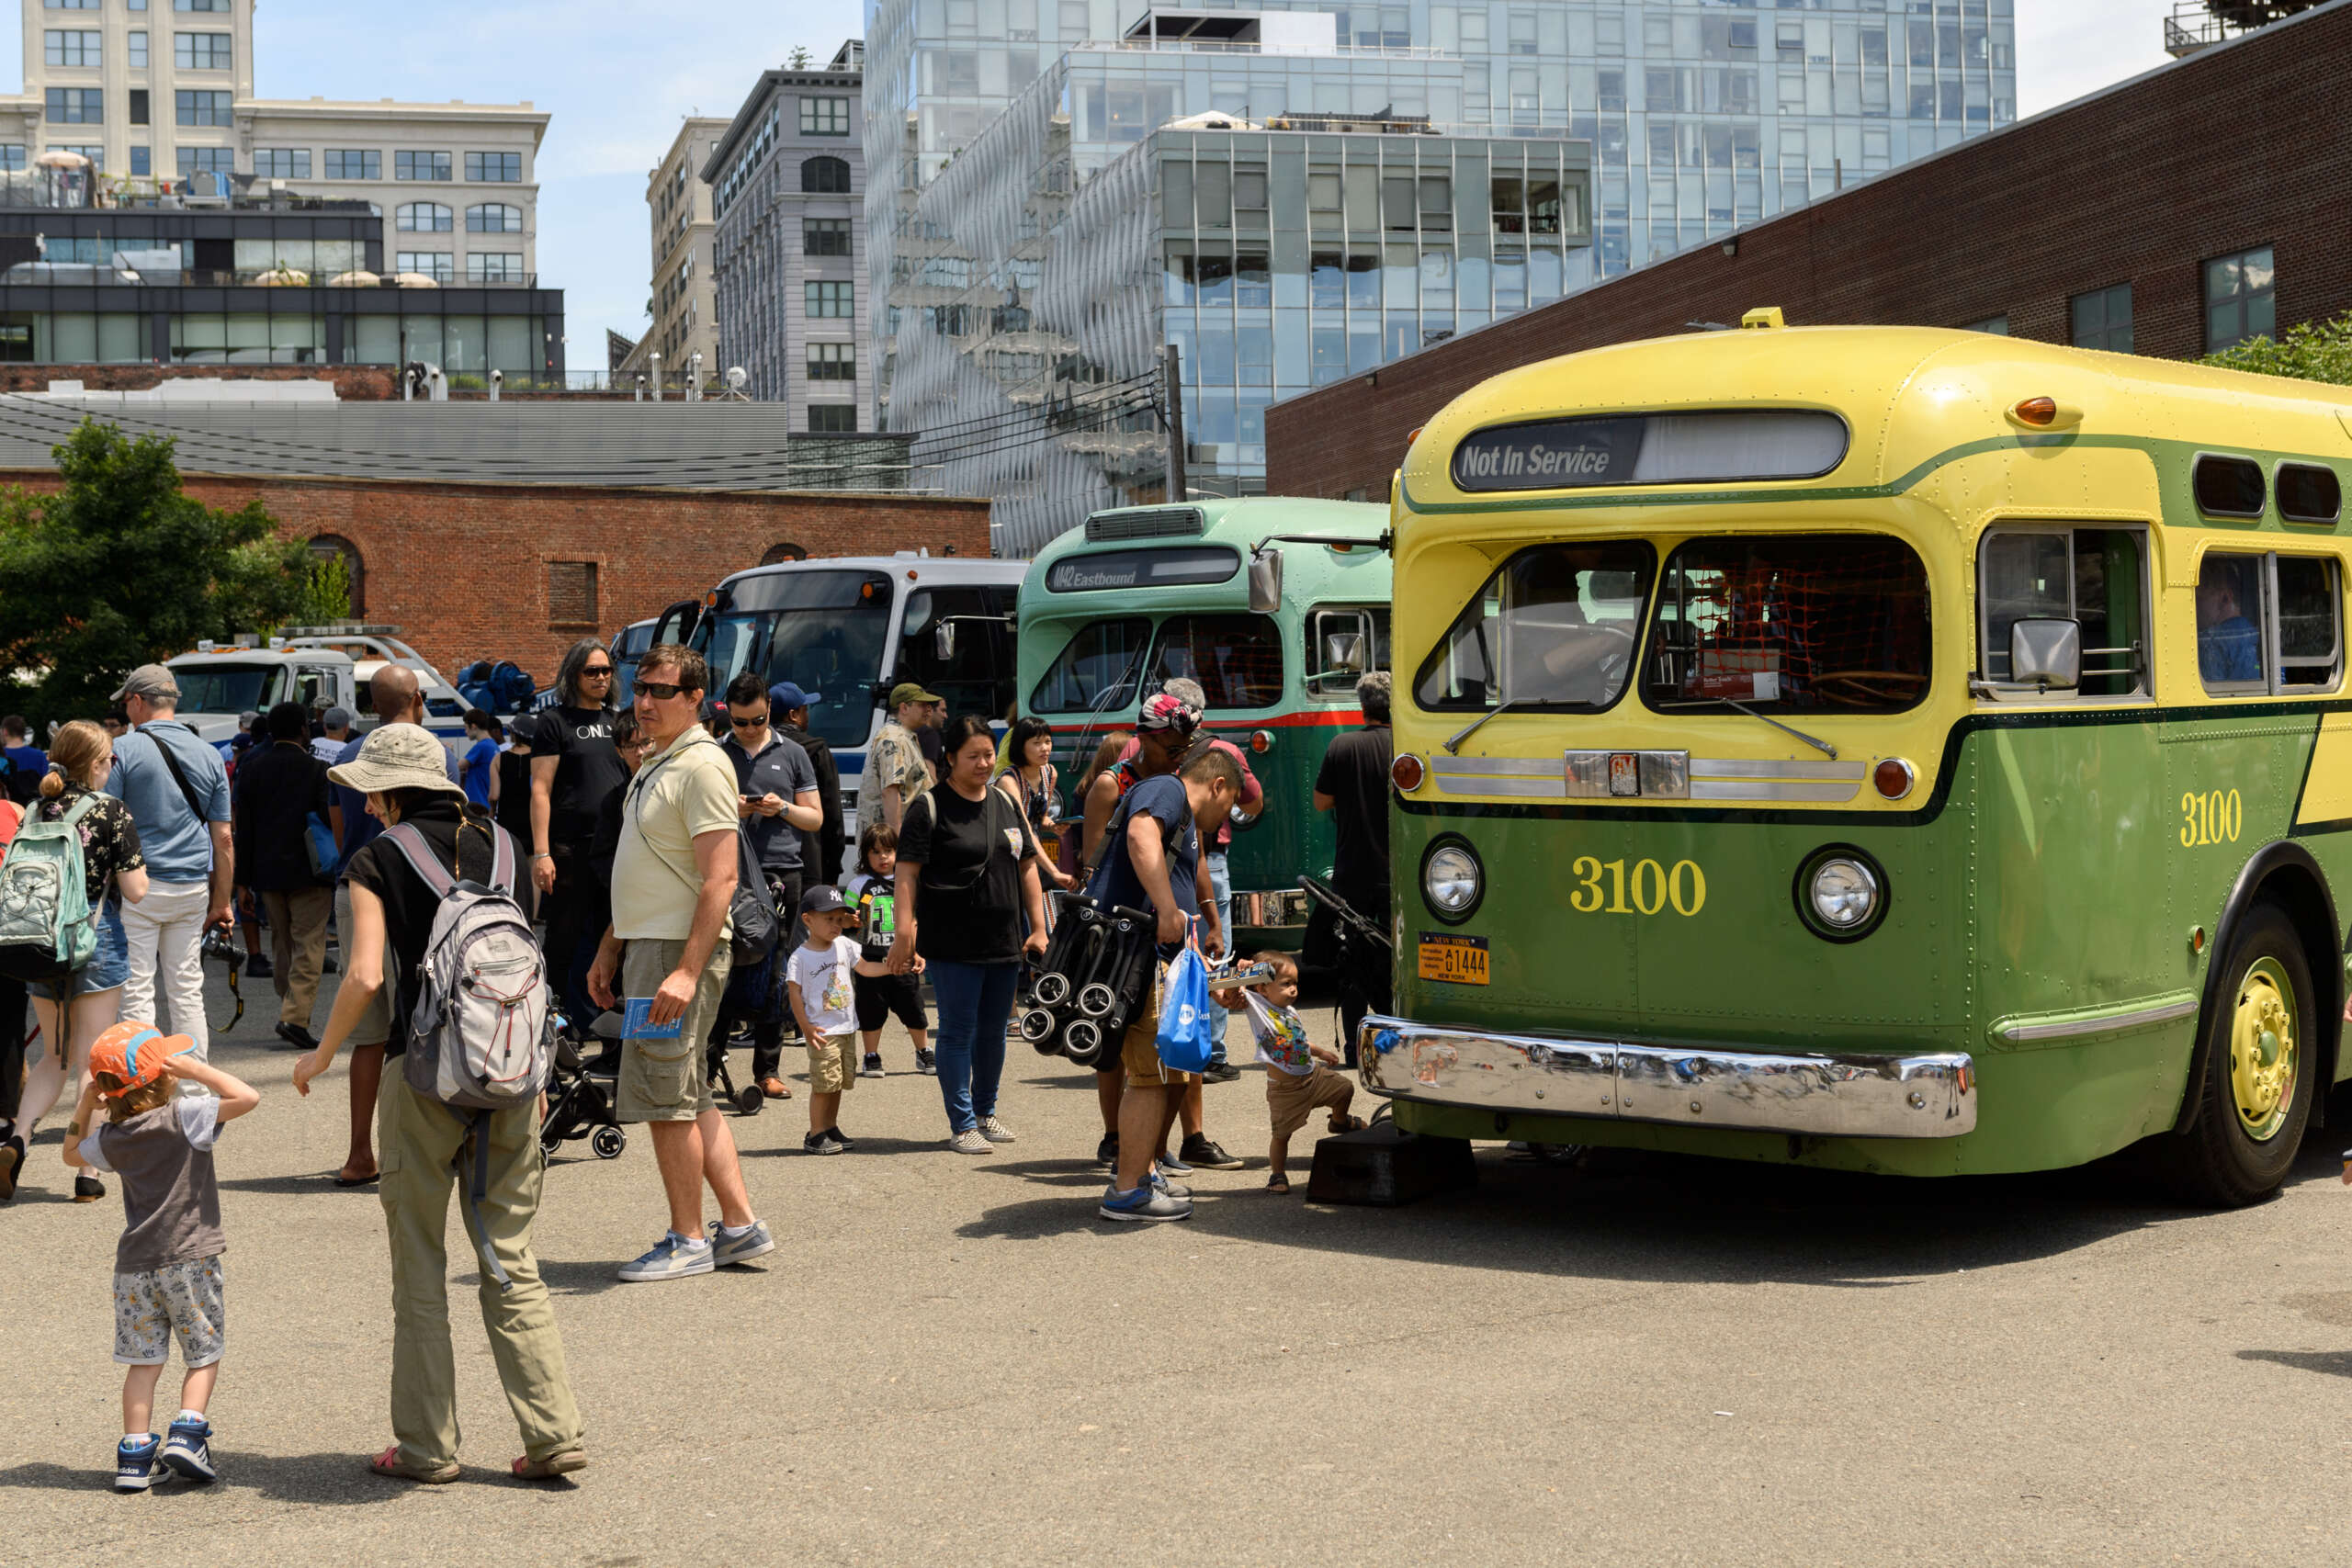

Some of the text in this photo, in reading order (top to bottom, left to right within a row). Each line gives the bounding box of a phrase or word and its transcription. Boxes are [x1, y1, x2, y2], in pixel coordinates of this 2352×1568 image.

[1462, 445, 1610, 477] Not In Service
[1053, 565, 1136, 588] M42 Eastbound
[2180, 788, 2242, 848] 3100
[1570, 856, 1706, 917] 3100
